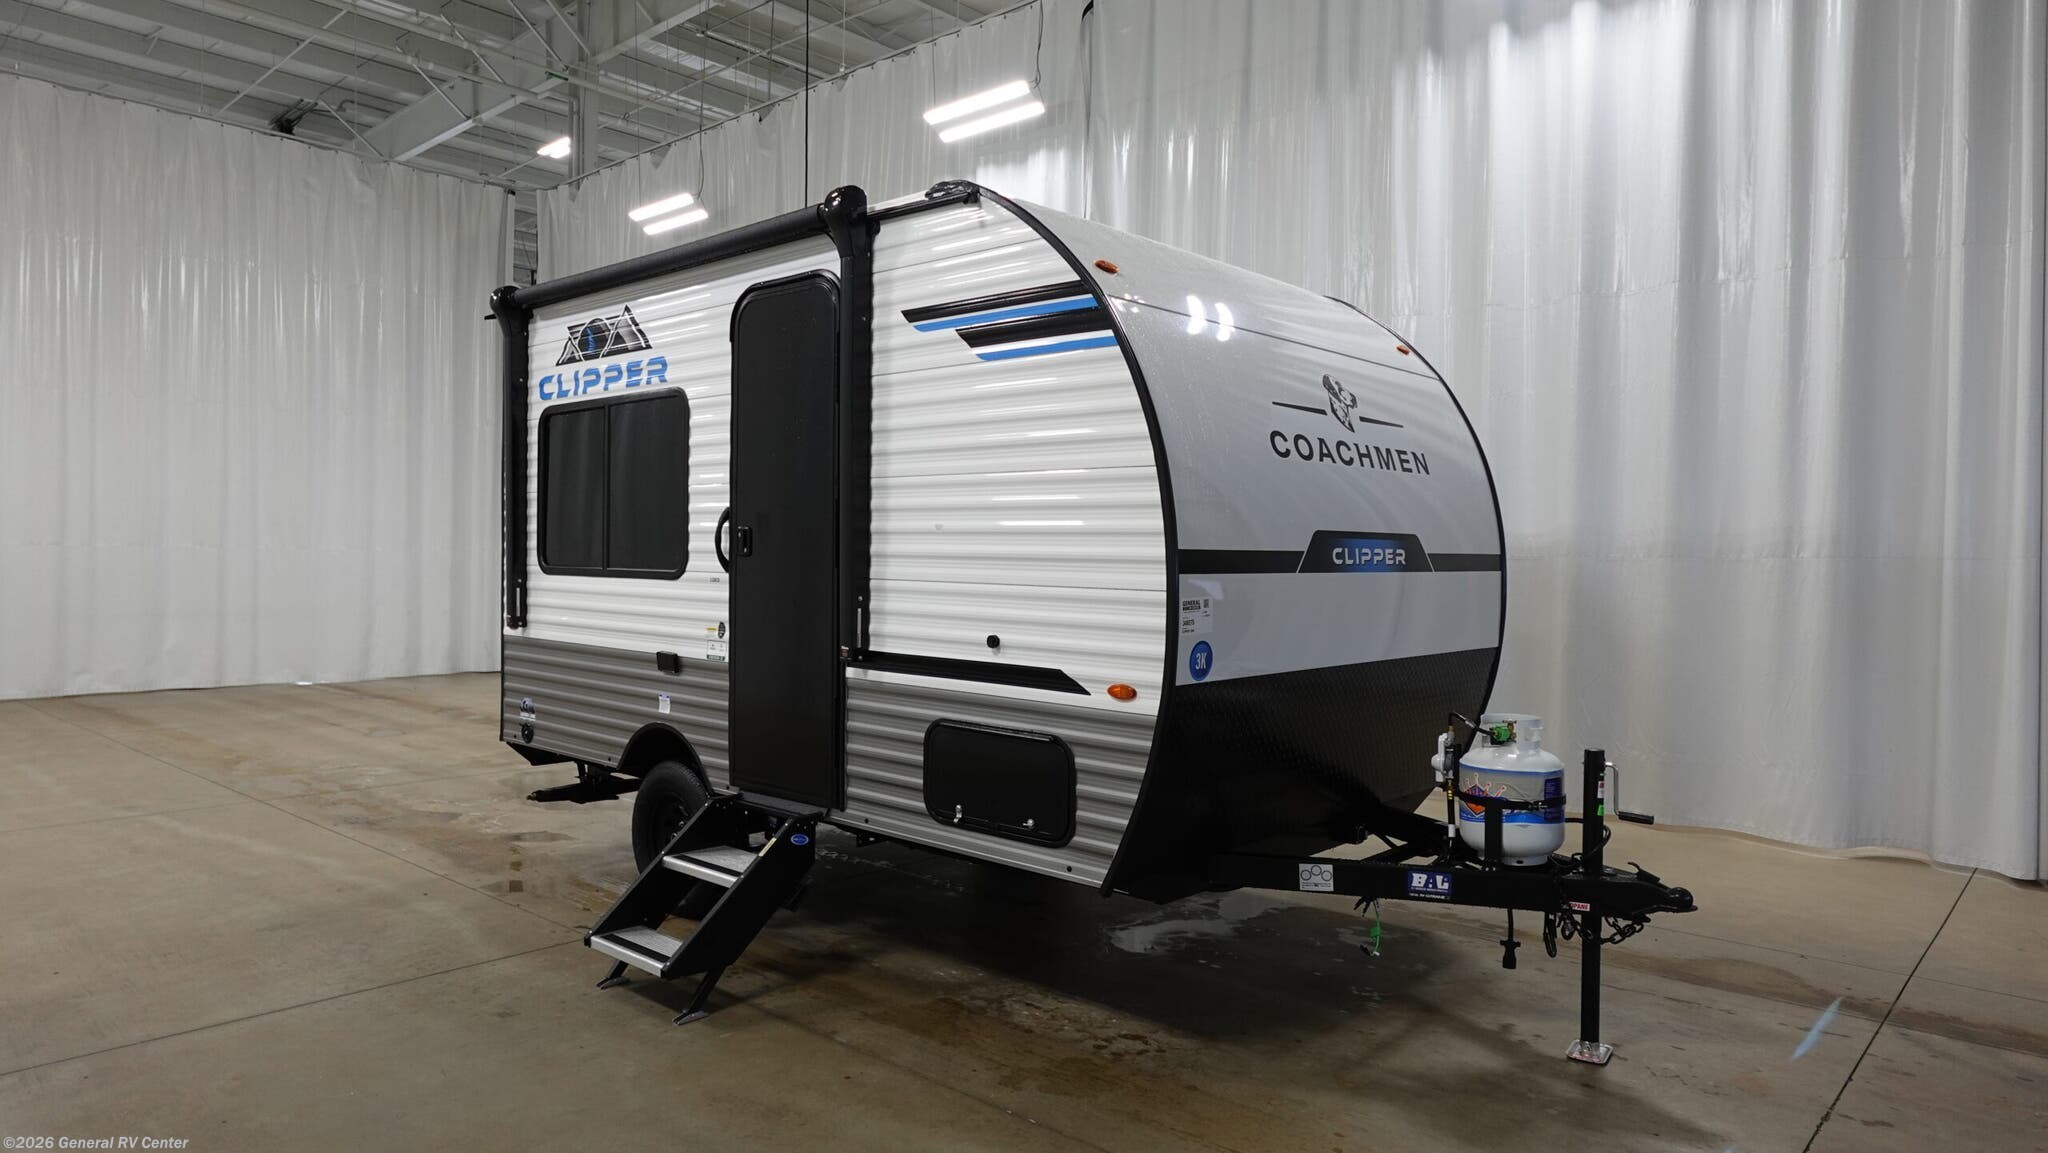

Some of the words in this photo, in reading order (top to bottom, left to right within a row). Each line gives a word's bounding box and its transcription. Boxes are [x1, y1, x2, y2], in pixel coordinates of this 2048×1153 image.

[539, 356, 668, 401] CLIPPER
[1269, 430, 1431, 475] COACHMEN
[1332, 547, 1406, 565] CLIPPER
[1195, 652, 1207, 670] 3K
